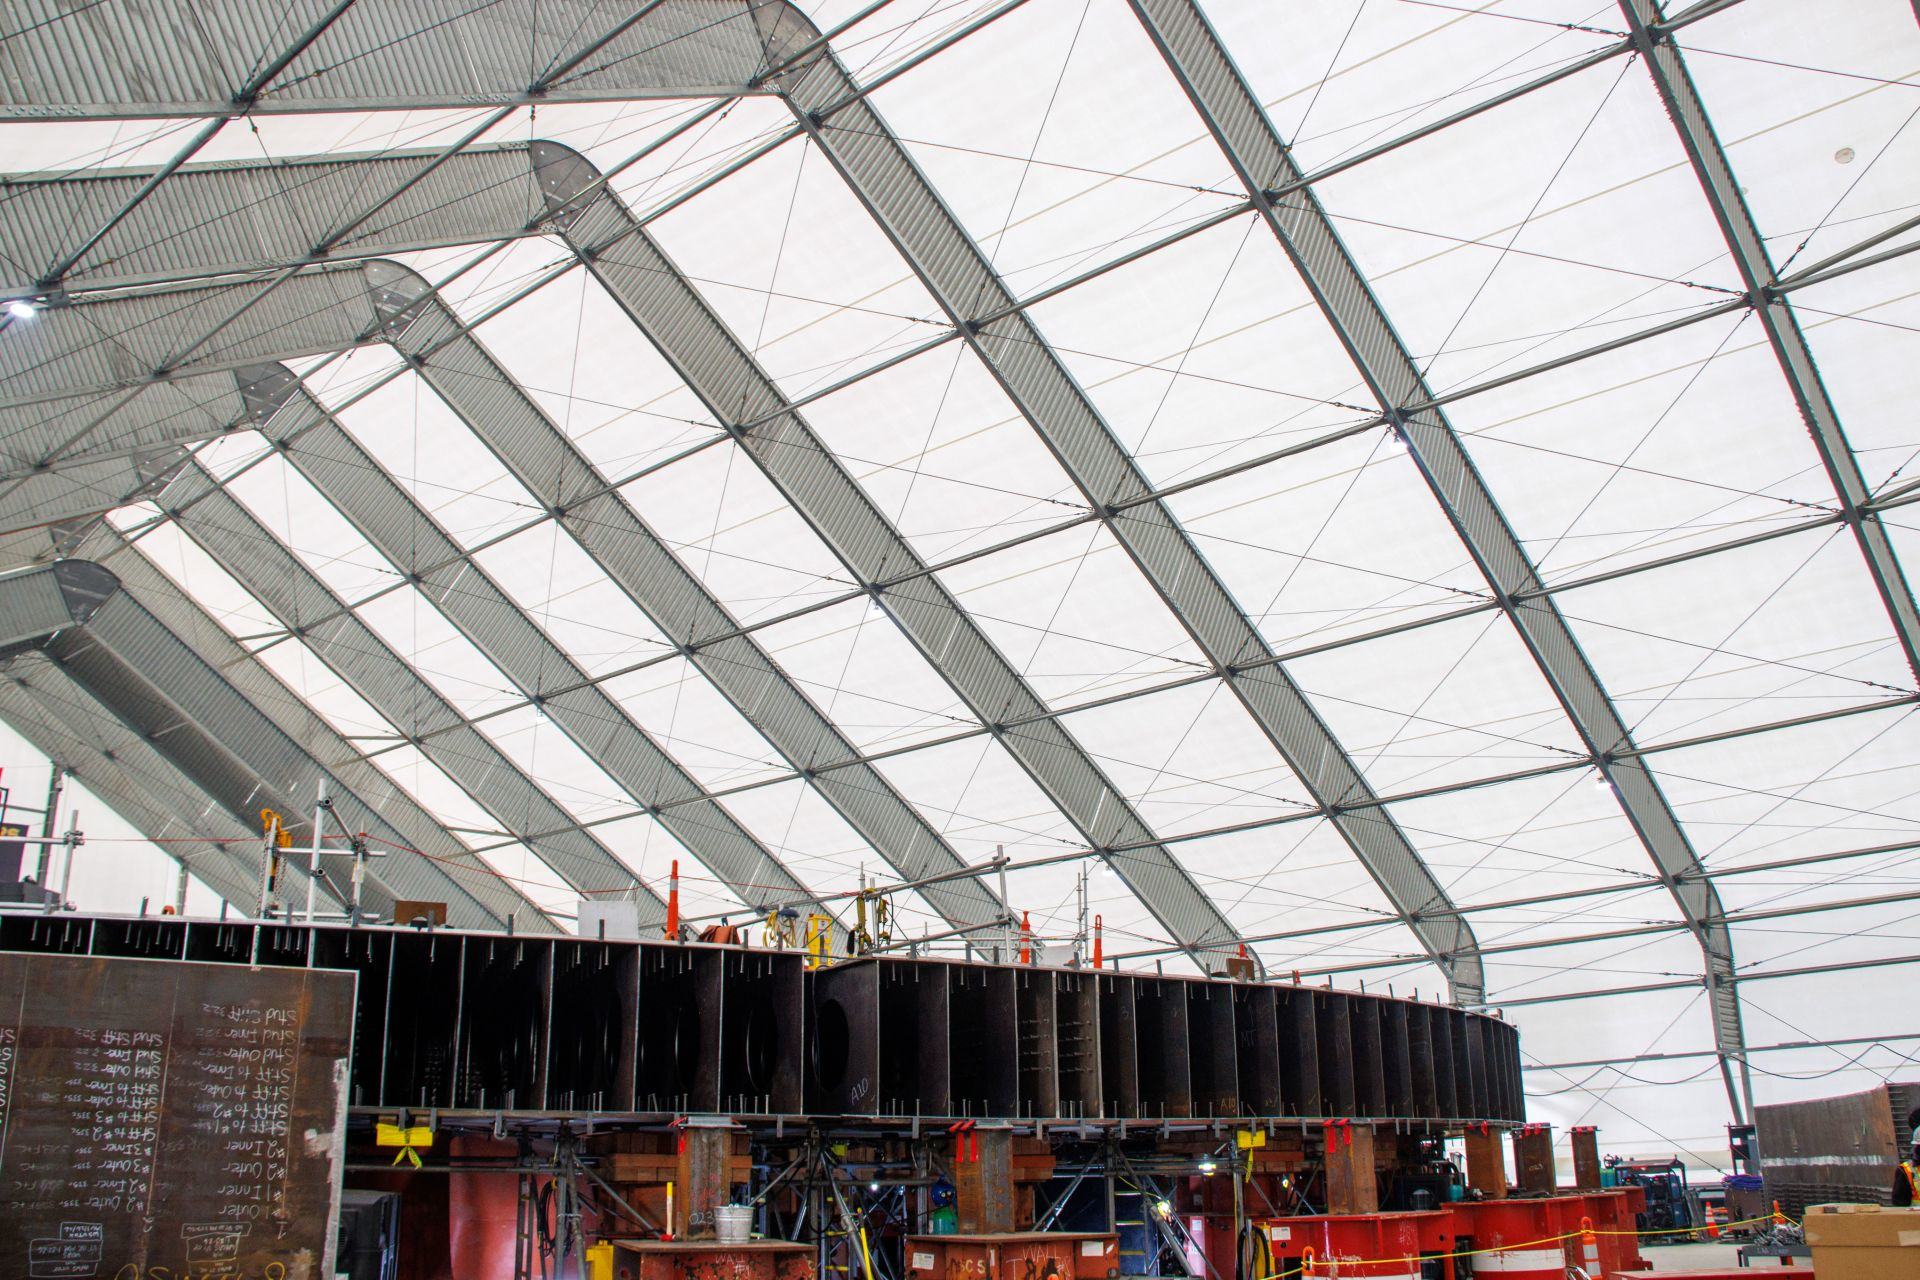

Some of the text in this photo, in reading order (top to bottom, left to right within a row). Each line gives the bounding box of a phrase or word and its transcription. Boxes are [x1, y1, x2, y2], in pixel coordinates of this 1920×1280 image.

[133, 1031, 164, 1047] Stud
[224, 1028, 257, 1043] Inner
[263, 1029, 296, 1045] Stud
[224, 1047, 261, 1063] Outer
[263, 1048, 295, 1065] Stud
[101, 1064, 131, 1078] Outer
[201, 1064, 235, 1080] Inner
[238, 1065, 251, 1080] to
[85, 1080, 114, 1094] Inner
[118, 1083, 128, 1096] to
[199, 1083, 232, 1099] Outer
[234, 1084, 246, 1101] to
[84, 1095, 114, 1108] Outer
[117, 1096, 128, 1108] to
[95, 1110, 114, 1124] #3
[118, 1111, 129, 1123] to
[234, 1102, 248, 1117] to
[92, 1126, 113, 1141] #2
[115, 1127, 126, 1139] to
[232, 1120, 246, 1134] to
[101, 1143, 133, 1156] Inner
[224, 1140, 263, 1156] Inner
[267, 1140, 285, 1159] #2
[97, 1159, 132, 1172] Outer
[220, 1162, 286, 1181] #2 Outer
[93, 1179, 127, 1194] Inner
[129, 1178, 147, 1193] #2
[217, 1185, 263, 1201] Inner
[83, 1195, 120, 1216] Outer
[126, 1196, 145, 1213] #2
[217, 1204, 261, 1220] Outer
